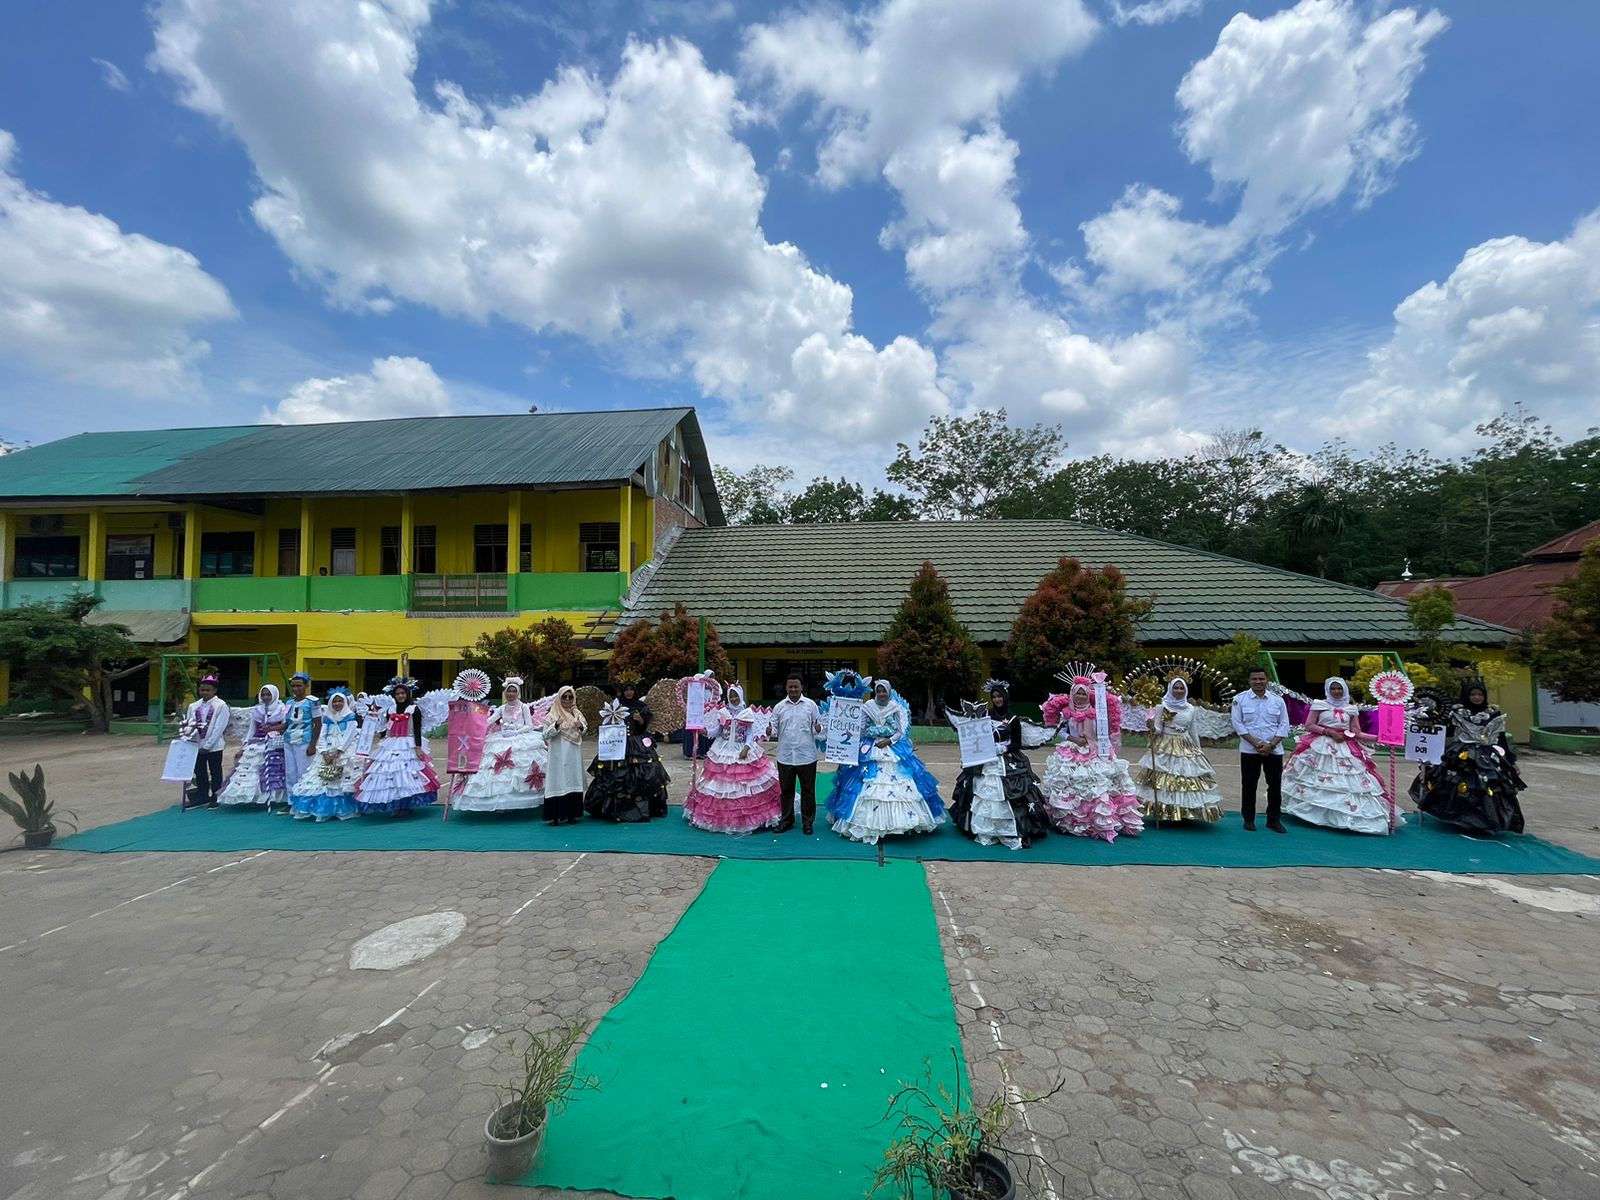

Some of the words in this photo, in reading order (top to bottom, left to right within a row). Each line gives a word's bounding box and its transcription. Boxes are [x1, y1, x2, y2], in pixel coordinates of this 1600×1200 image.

[1409, 724, 1443, 735] GROUP
[840, 731, 853, 745] 2
[1420, 735, 1427, 743] 2
[972, 736, 984, 754] 1
